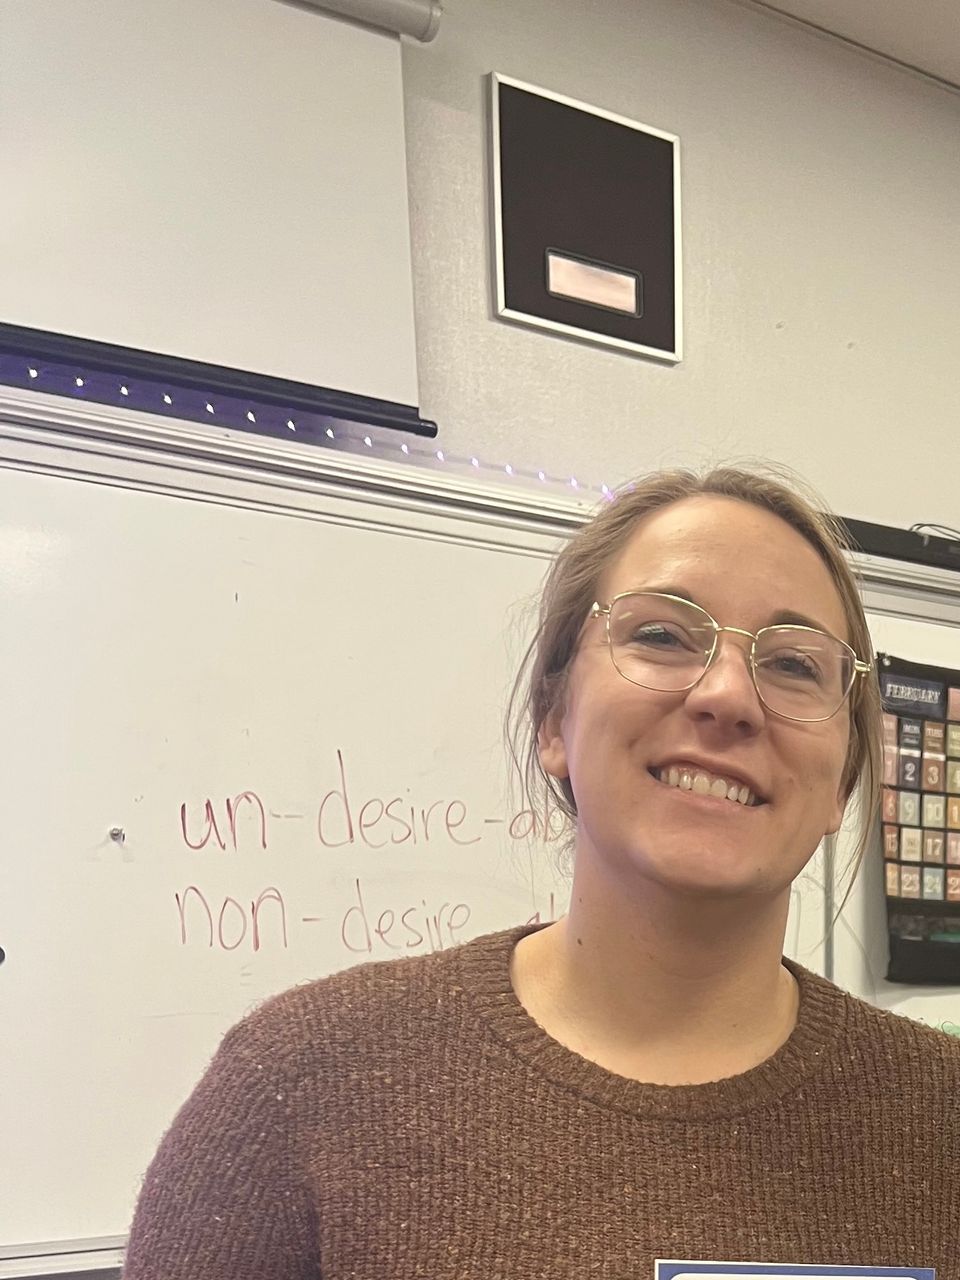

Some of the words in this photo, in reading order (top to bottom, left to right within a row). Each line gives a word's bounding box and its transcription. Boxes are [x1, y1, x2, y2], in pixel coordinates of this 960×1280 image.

[905, 763, 916, 782] 2
[928, 766, 939, 785] 3
[905, 800, 915, 821] 9
[926, 803, 943, 821] 10
[927, 839, 943, 856] 17
